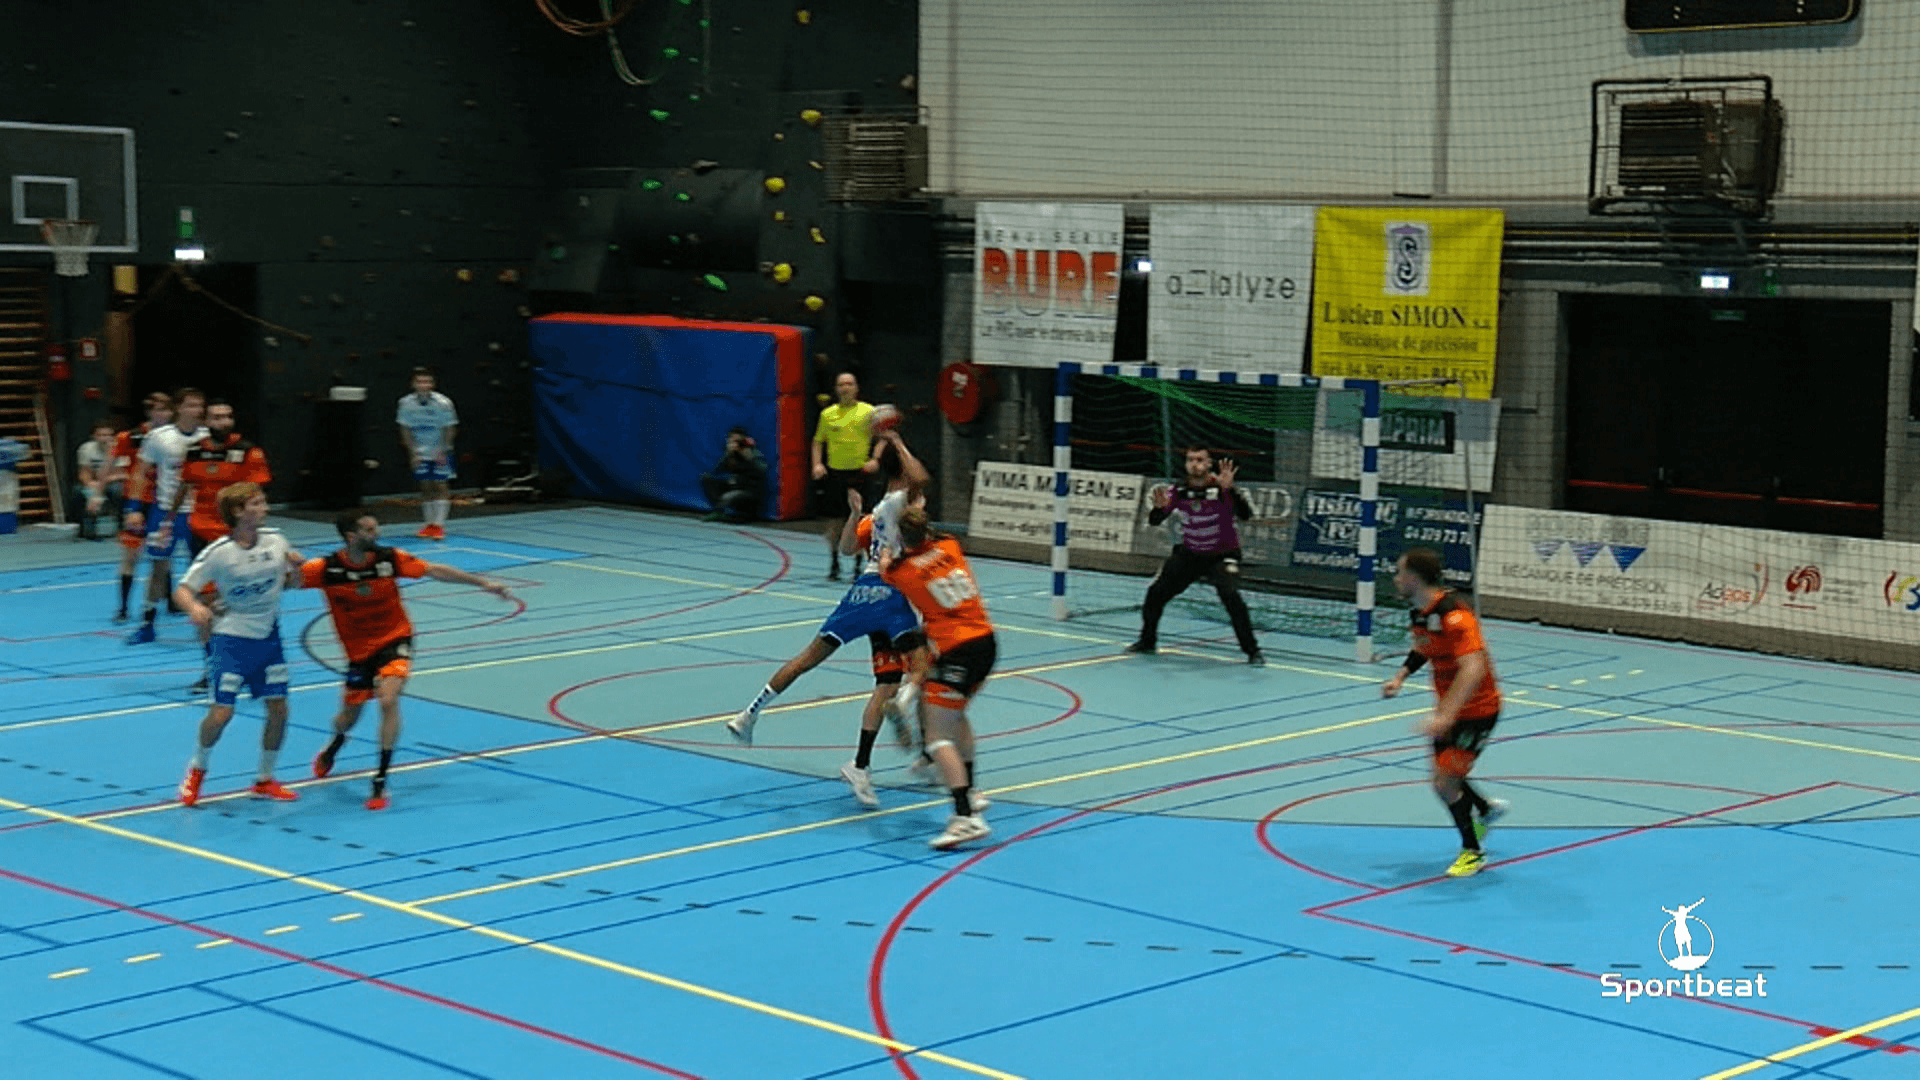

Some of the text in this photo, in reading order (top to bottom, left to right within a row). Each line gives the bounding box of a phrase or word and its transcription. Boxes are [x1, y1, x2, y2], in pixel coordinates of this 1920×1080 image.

[1323, 301, 1384, 326] Lucien
[1390, 303, 1466, 329] SIMON
[981, 470, 1029, 490] VIMA
[1115, 486, 1135, 500] sa
